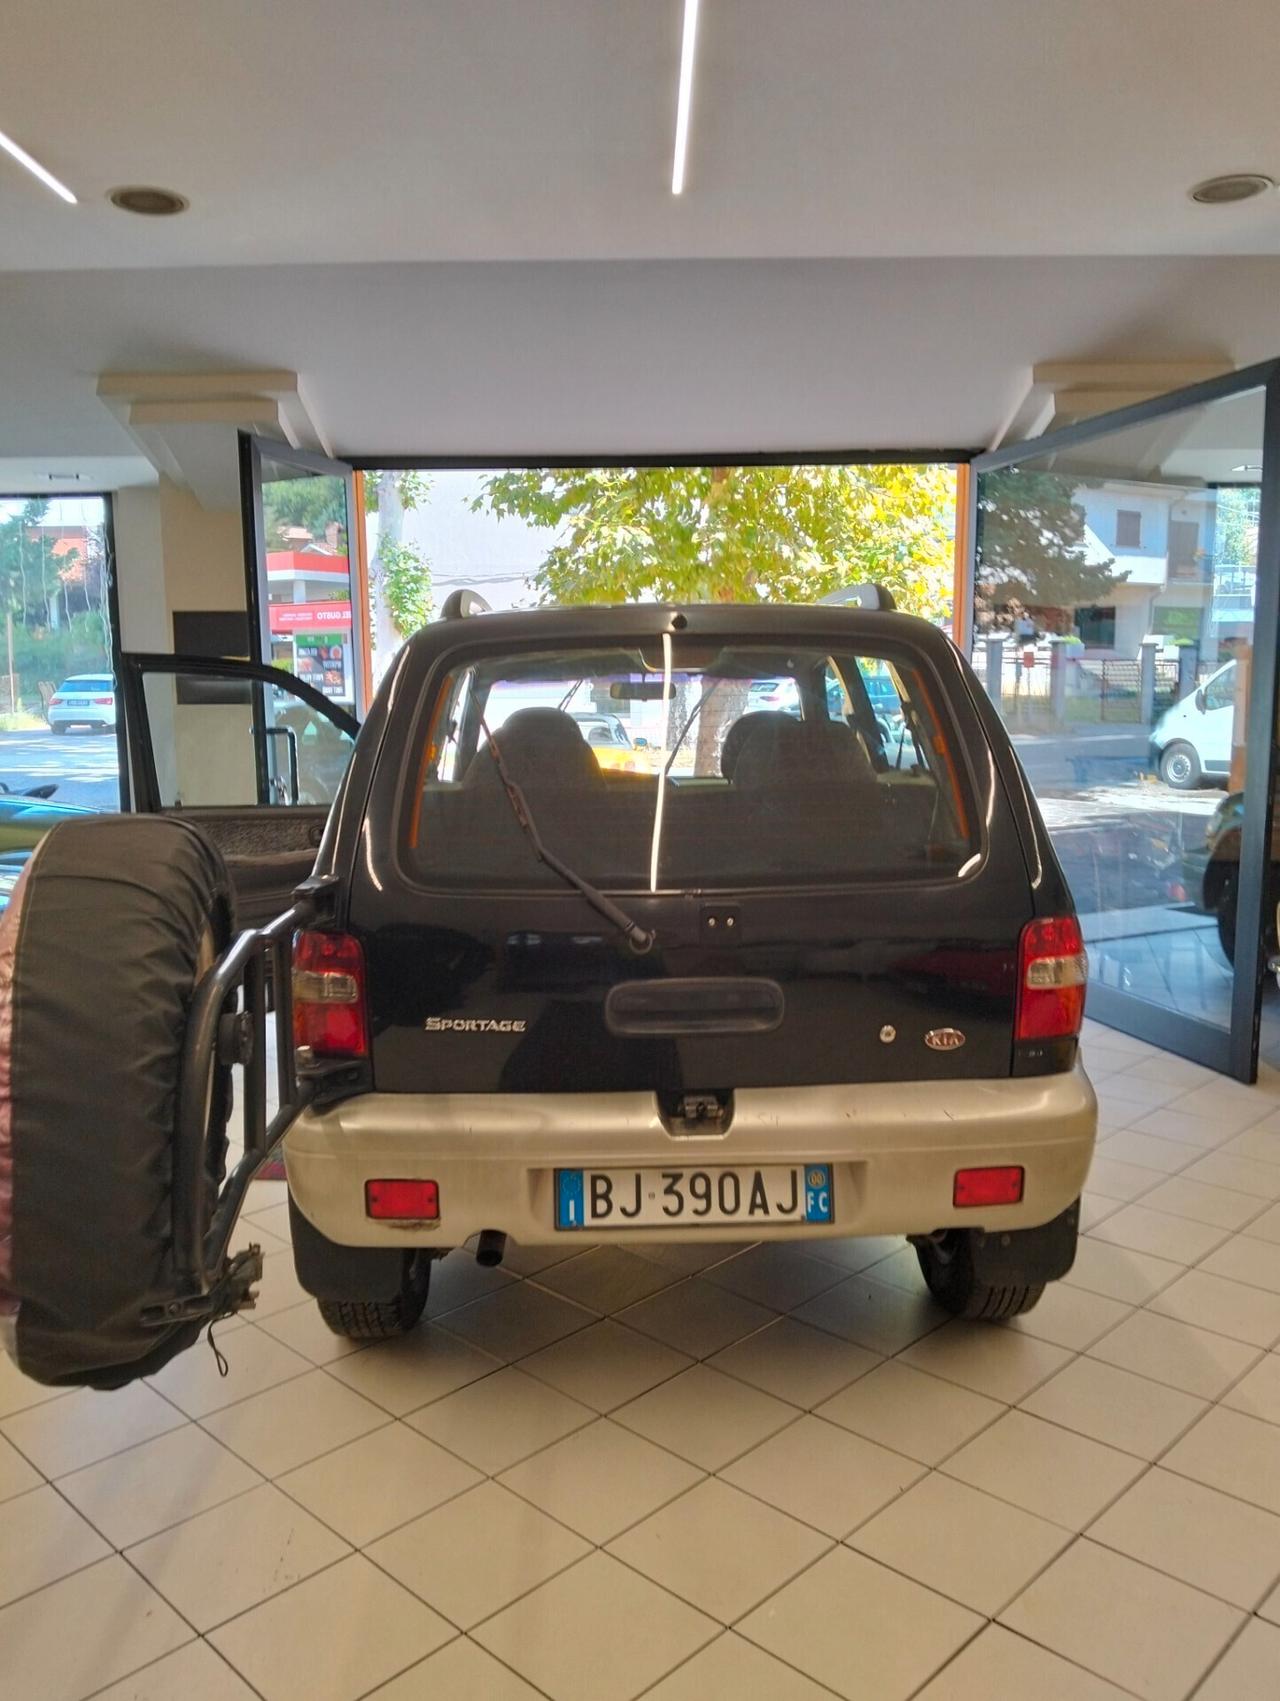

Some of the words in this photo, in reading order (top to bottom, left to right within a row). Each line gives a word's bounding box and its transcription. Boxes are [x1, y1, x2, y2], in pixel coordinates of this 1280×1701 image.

[424, 1017, 527, 1032] SPORTAGE
[932, 1031, 960, 1046] KIA
[569, 1199, 575, 1221] I
[807, 1191, 828, 1213] FC
